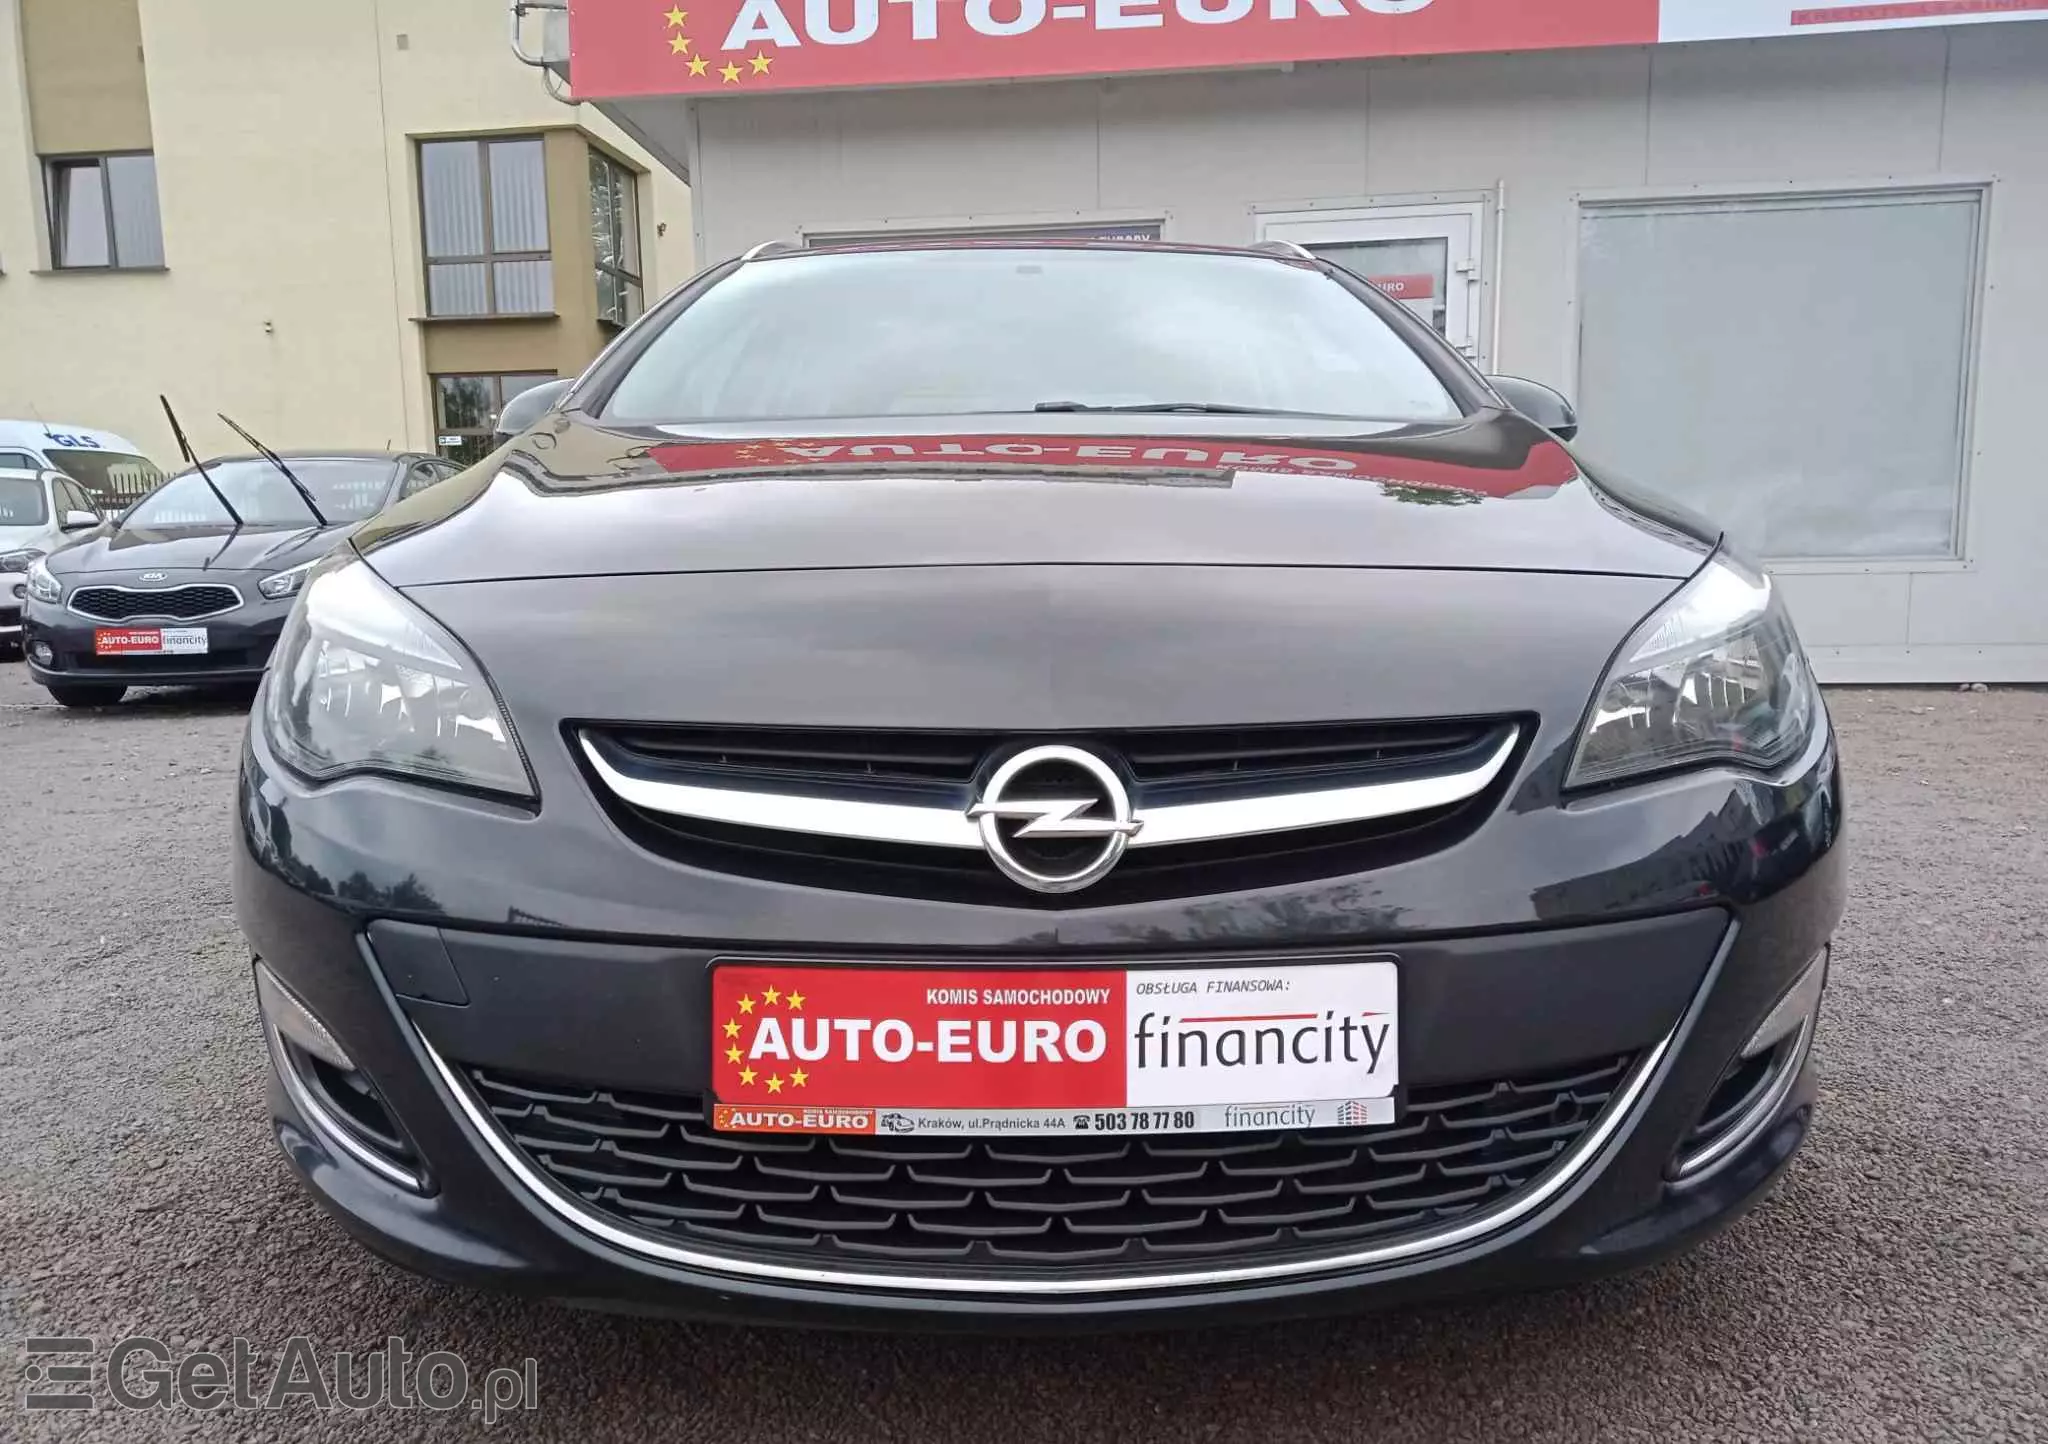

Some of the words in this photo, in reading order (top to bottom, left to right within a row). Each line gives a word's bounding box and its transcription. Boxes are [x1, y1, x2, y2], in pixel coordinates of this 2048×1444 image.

[720, 0, 1436, 51] AUTO-E
[52, 433, 101, 448] GLS
[101, 635, 159, 645] AUTO-EURO
[1136, 981, 1197, 995] OBSŁUGA
[1206, 979, 1291, 994] FINANSOWA:
[926, 988, 979, 1005] KOMIS
[983, 988, 1111, 1005] SAMOCHODOWY
[748, 1016, 1107, 1064] AUTO-EURO
[1134, 1010, 1390, 1074] financity
[730, 1112, 868, 1129] AUTO-EURO
[917, 1117, 965, 1130] Kraków,
[1043, 1117, 1066, 1129] 44A
[1095, 1112, 1126, 1131] 503
[1130, 1111, 1150, 1130] 78
[1153, 1111, 1171, 1129] 77
[1174, 1111, 1195, 1129] 80
[1224, 1103, 1316, 1128] financity
